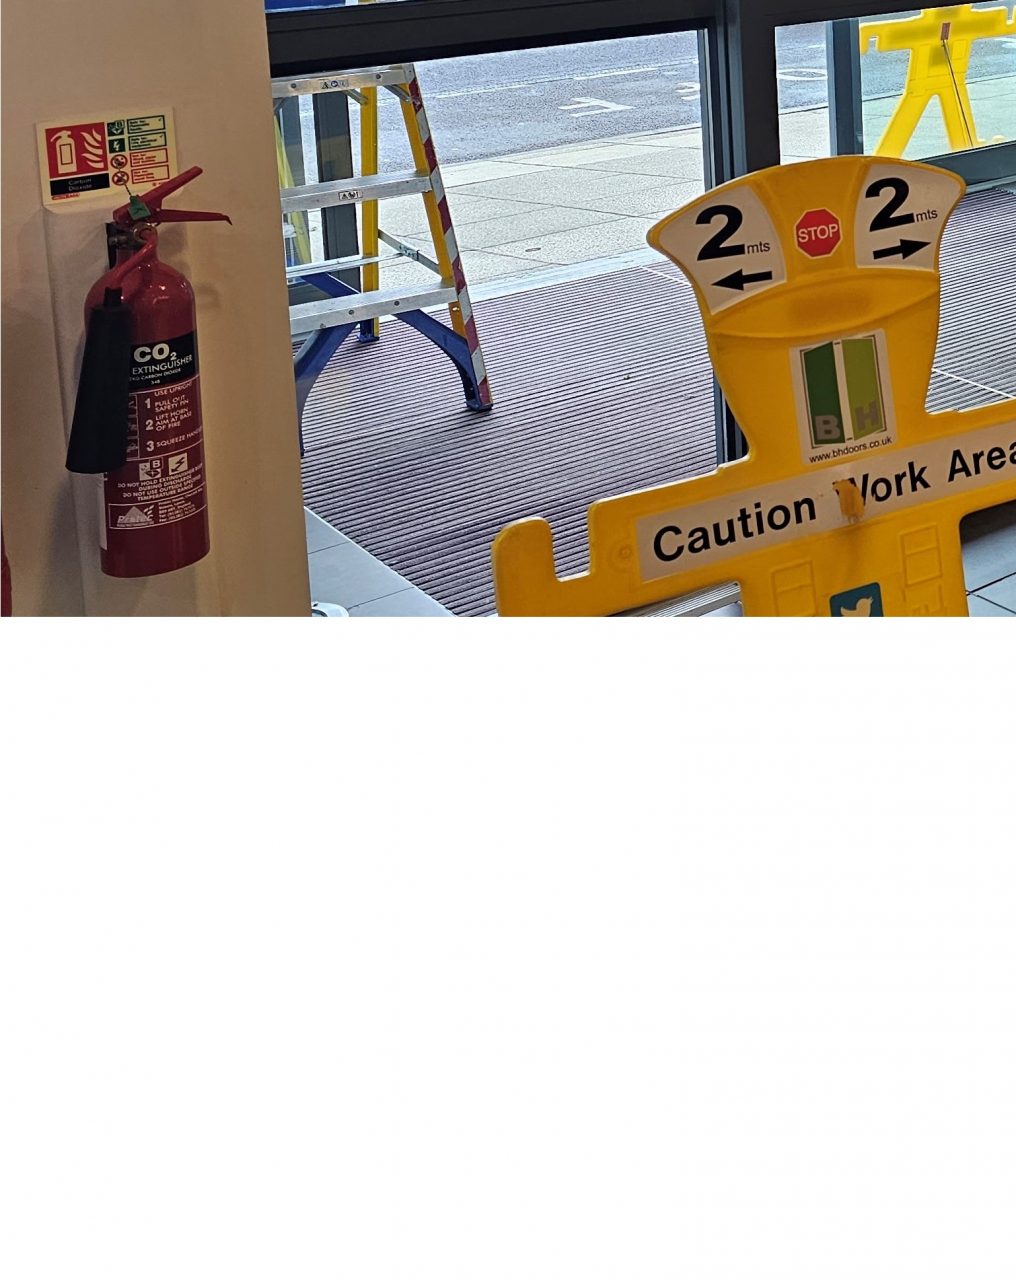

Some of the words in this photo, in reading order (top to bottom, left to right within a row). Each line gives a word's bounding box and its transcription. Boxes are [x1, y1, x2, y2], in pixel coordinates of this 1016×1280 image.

[865, 177, 915, 232] 2
[915, 208, 938, 223] mts
[695, 204, 746, 261] 2
[746, 240, 771, 255] mts
[798, 223, 838, 242] STOP
[132, 354, 192, 375] EXTINGUISHER
[144, 398, 151, 409] 1
[145, 419, 154, 431] 2
[146, 440, 155, 451] 3
[808, 436, 892, 463] www.bhdoors.co.uk
[653, 496, 817, 562] Caution
